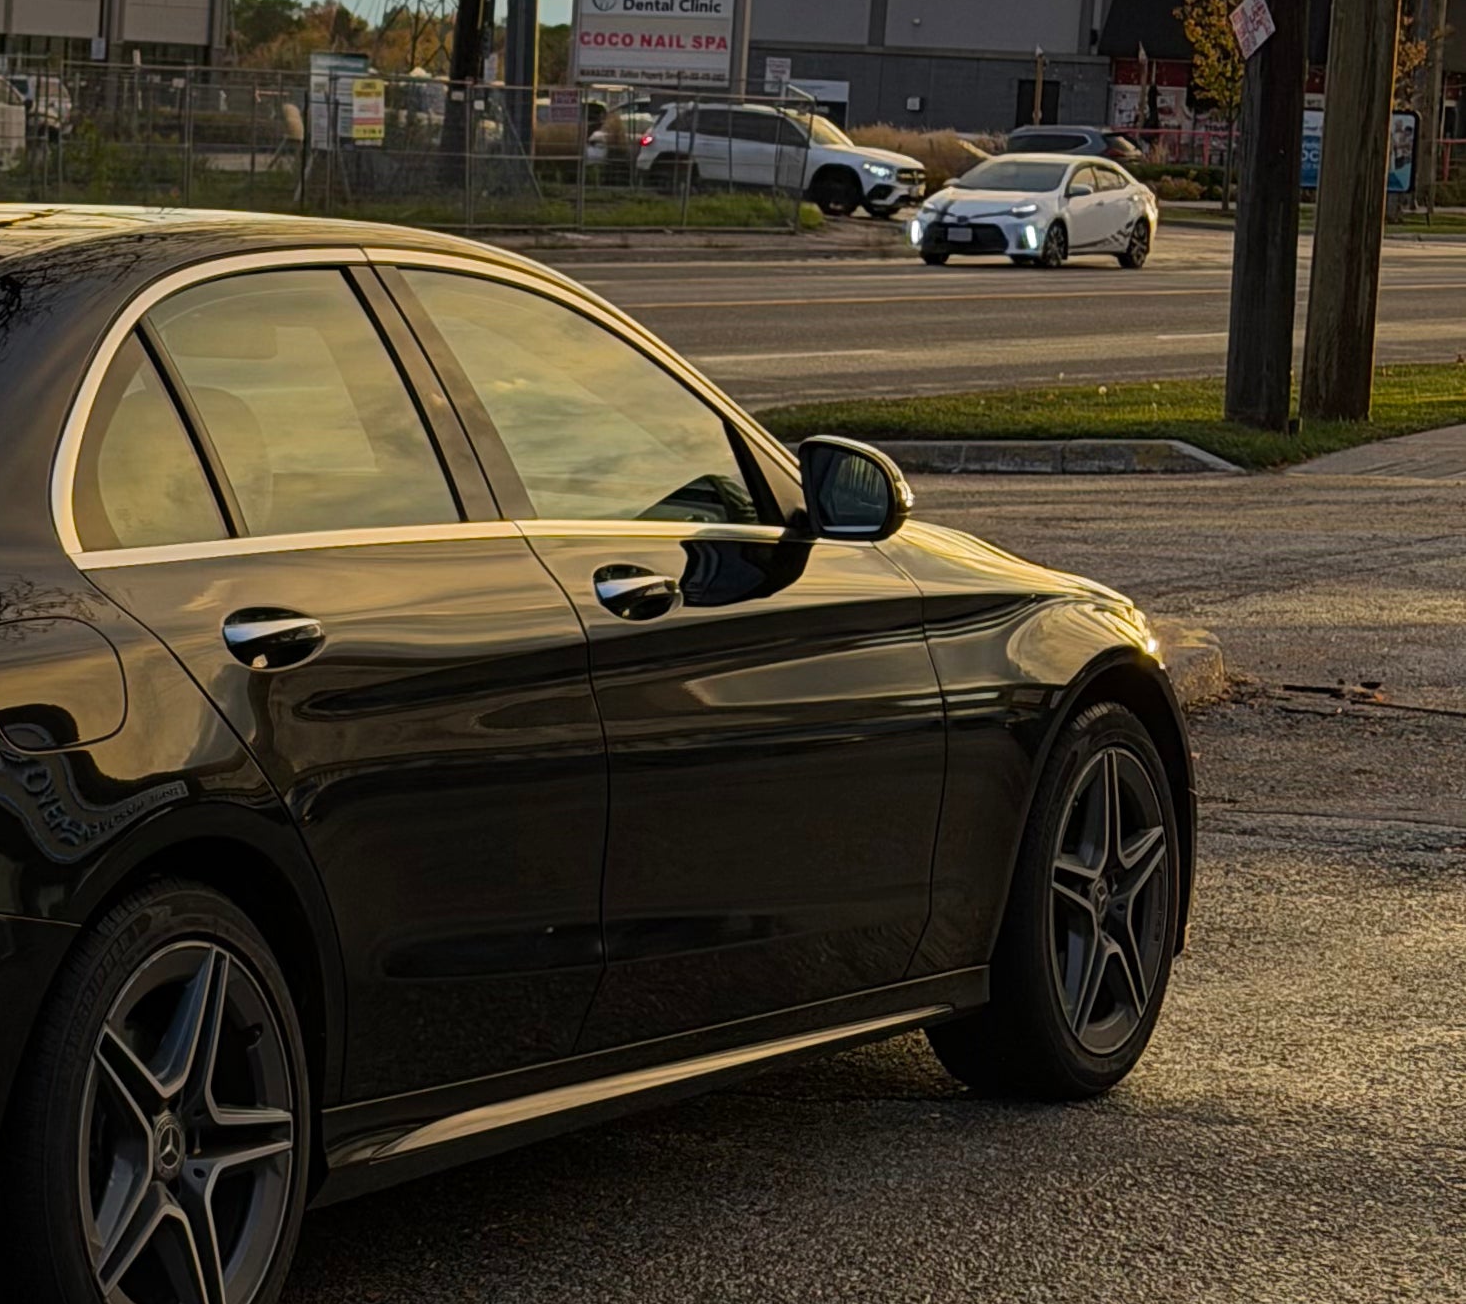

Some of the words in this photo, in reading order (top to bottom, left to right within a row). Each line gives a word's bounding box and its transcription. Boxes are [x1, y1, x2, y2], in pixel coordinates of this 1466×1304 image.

[679, 0, 723, 13] Clinic
[580, 32, 634, 47] COCO
[640, 34, 687, 49] NAIL
[691, 35, 728, 51] SPA
